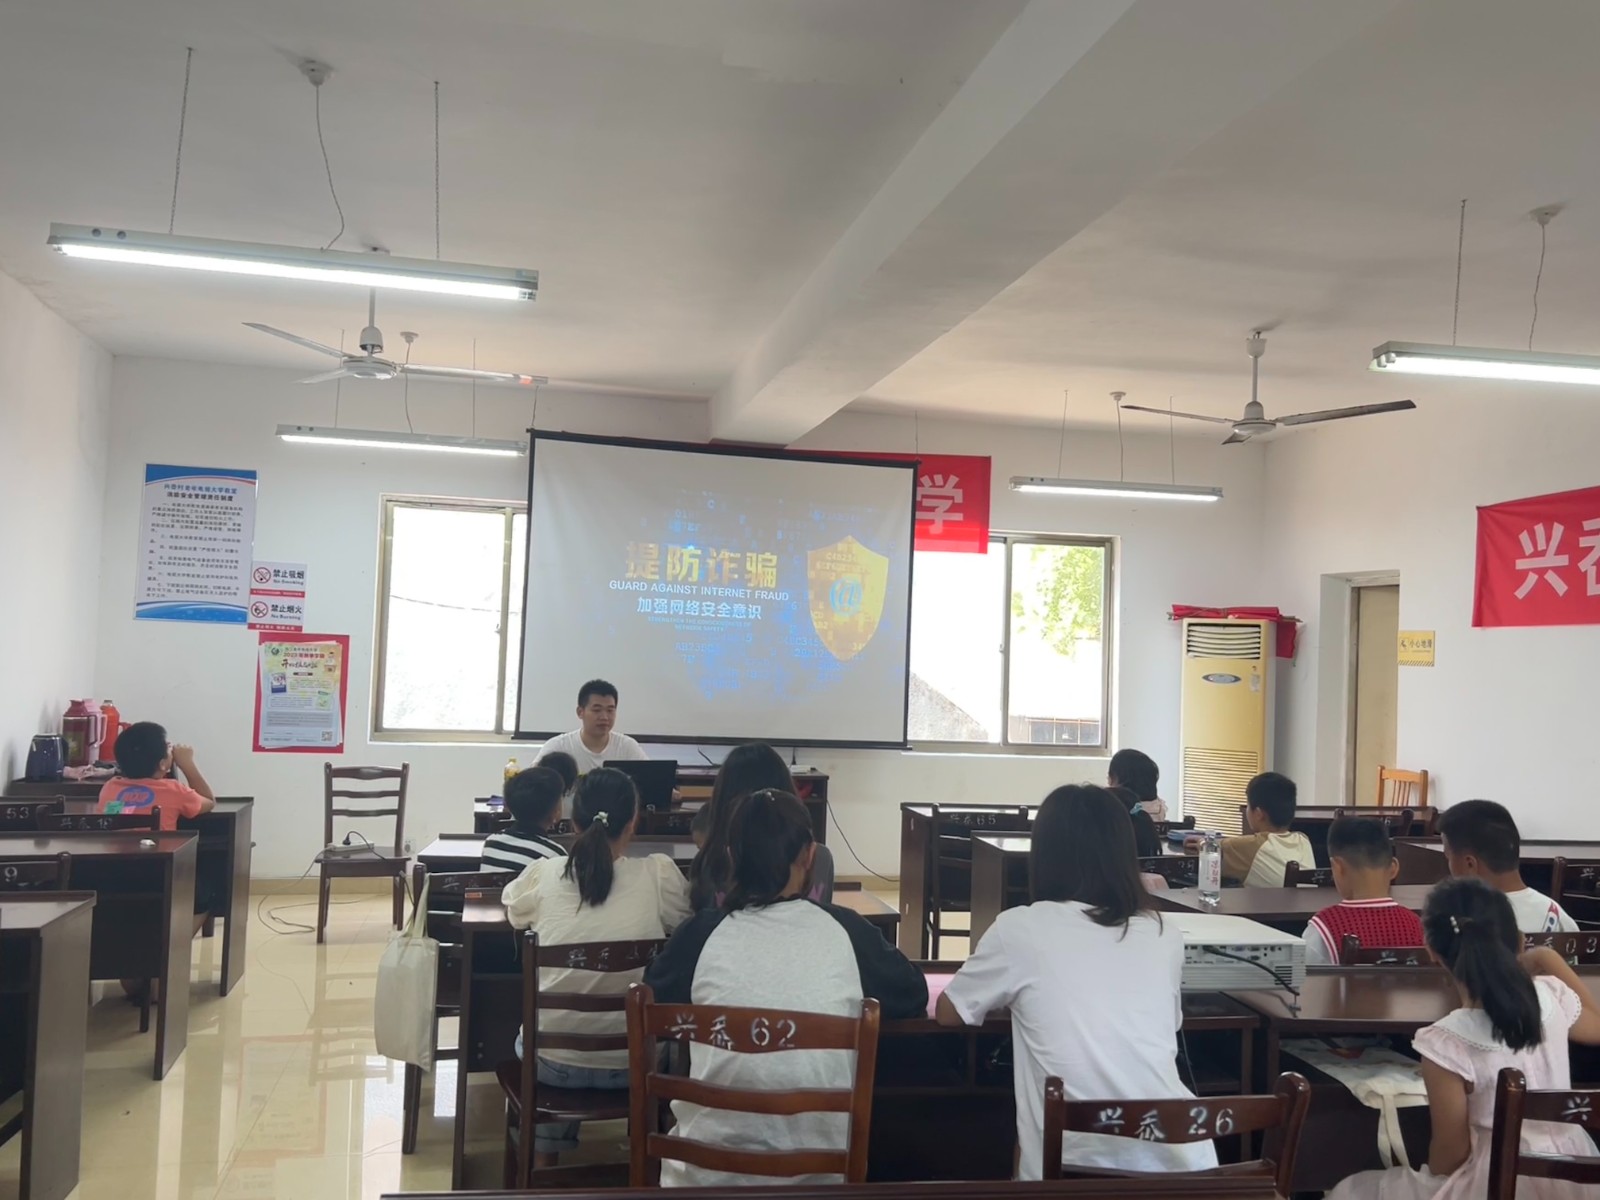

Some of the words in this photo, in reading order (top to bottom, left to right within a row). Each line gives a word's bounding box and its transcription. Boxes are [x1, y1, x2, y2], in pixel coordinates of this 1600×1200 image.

[915, 474, 963, 534] 学
[273, 569, 304, 579] 禁止吸烟
[625, 542, 777, 588] 提防诈骗
[609, 580, 648, 592] GUARD
[651, 585, 698, 595] AGAINST
[701, 587, 751, 599] INTERNET
[754, 591, 789, 601] FRAUD
[271, 604, 302, 614] 禁止烟火
[637, 597, 762, 620] 加强网络安全意识
[6, 806, 29, 820] 53
[750, 1017, 796, 1048] 62
[1188, 1096, 1234, 1136] 26
